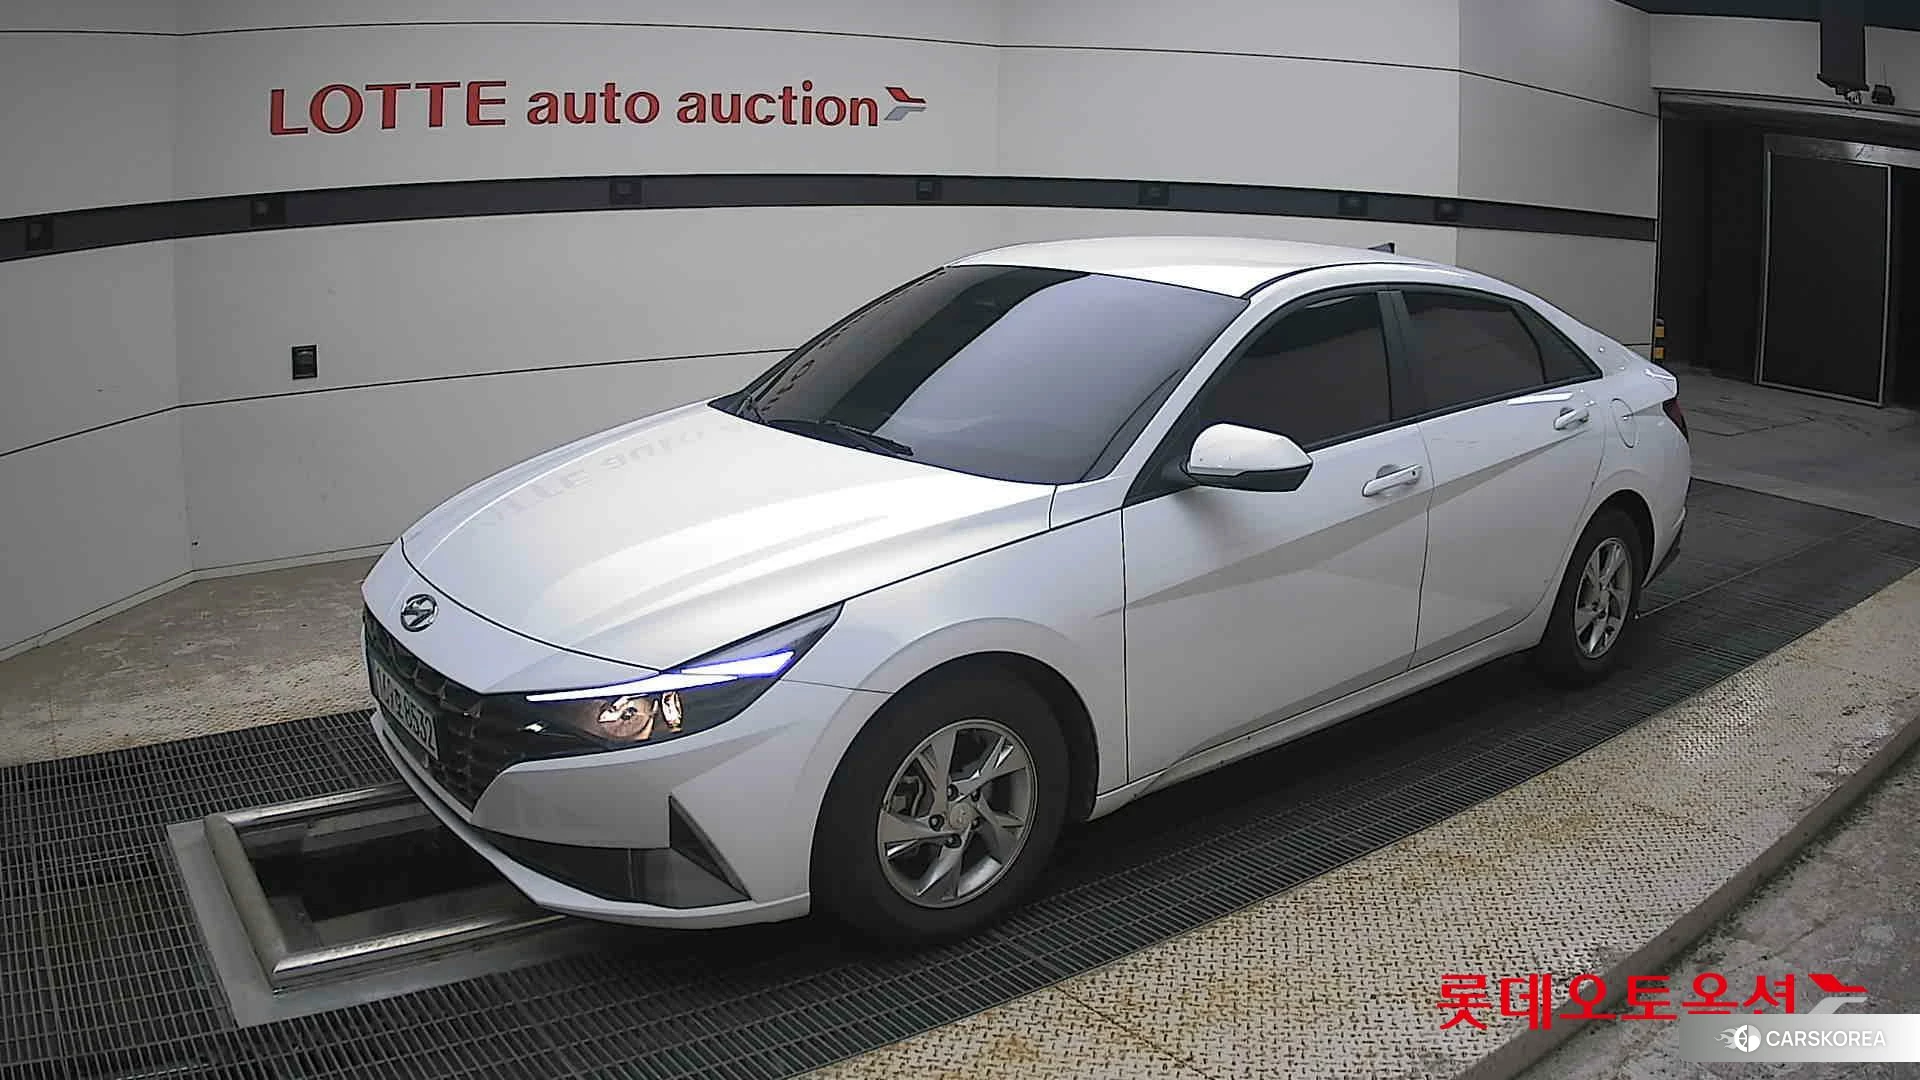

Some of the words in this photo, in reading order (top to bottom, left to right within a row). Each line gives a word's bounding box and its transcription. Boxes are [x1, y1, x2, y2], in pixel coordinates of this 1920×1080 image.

[270, 81, 507, 136] LOTTE
[527, 82, 660, 126] auto
[676, 80, 879, 127] auction
